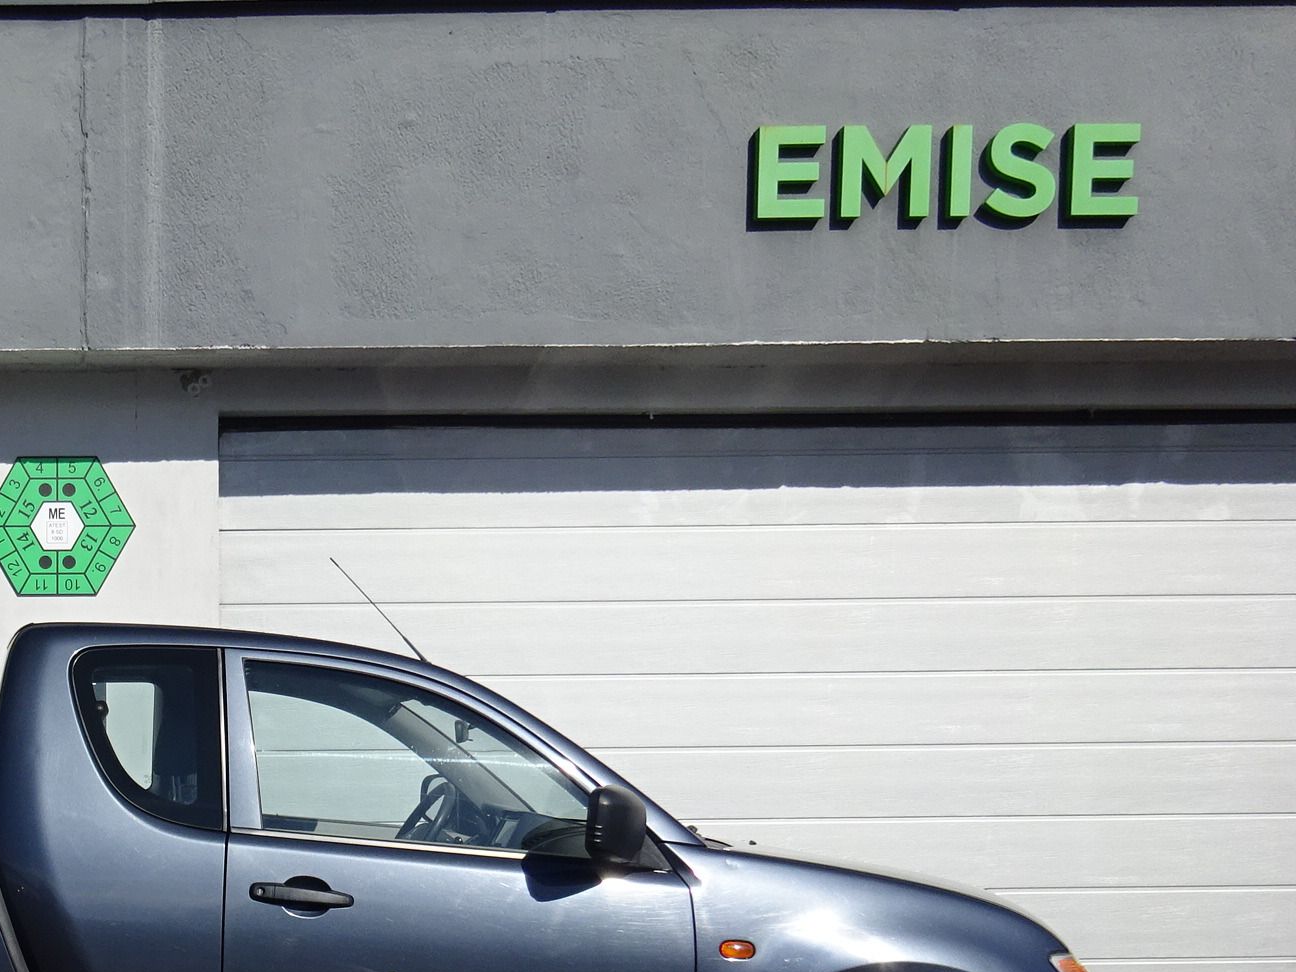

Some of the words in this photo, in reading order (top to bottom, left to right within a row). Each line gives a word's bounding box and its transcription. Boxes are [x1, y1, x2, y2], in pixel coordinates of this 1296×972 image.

[749, 122, 1141, 222] EMISE
[35, 462, 44, 474] 4
[68, 462, 77, 474] 5
[9, 478, 21, 490] 3
[17, 500, 35, 520] 15
[48, 507, 66, 520] ME
[79, 500, 98, 519] 12
[111, 505, 122, 514] 7
[16, 531, 36, 551] 14
[80, 532, 98, 552] 13
[109, 536, 121, 546] 8
[7, 560, 23, 577] 12
[35, 579, 49, 590] 11
[64, 578, 81, 591] 10
